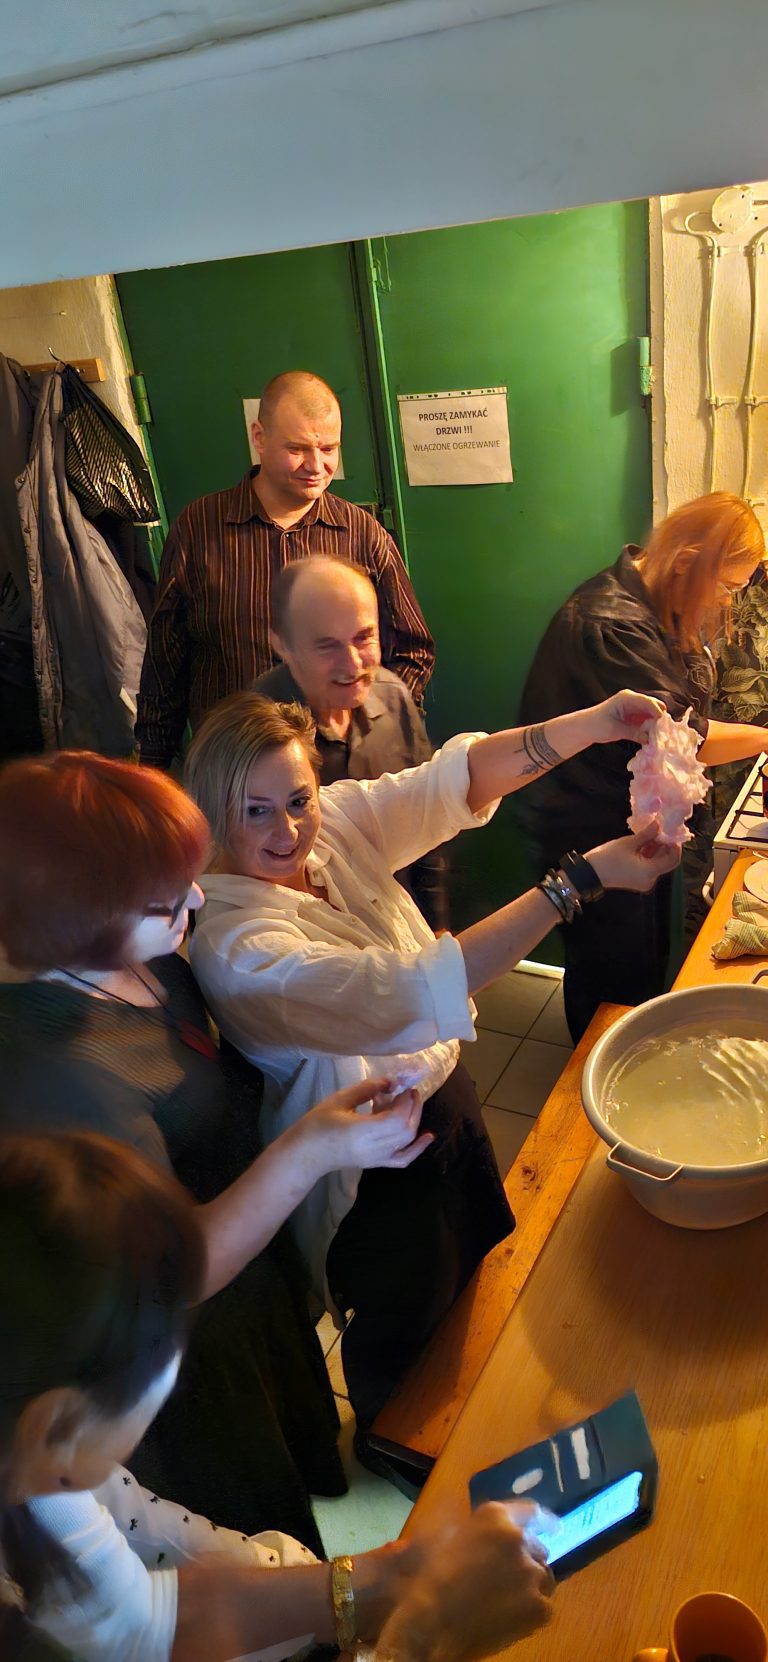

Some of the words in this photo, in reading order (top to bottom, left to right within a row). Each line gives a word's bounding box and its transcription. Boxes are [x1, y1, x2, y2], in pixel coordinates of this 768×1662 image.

[418, 412, 448, 422] PROSZĘ
[449, 408, 488, 420] ZAMYKAĆ
[436, 426, 462, 436] DRZWI
[464, 425, 473, 434] !!!
[413, 443, 451, 453] WŁĄCZONE
[453, 440, 500, 450] OGRZEWANIE
